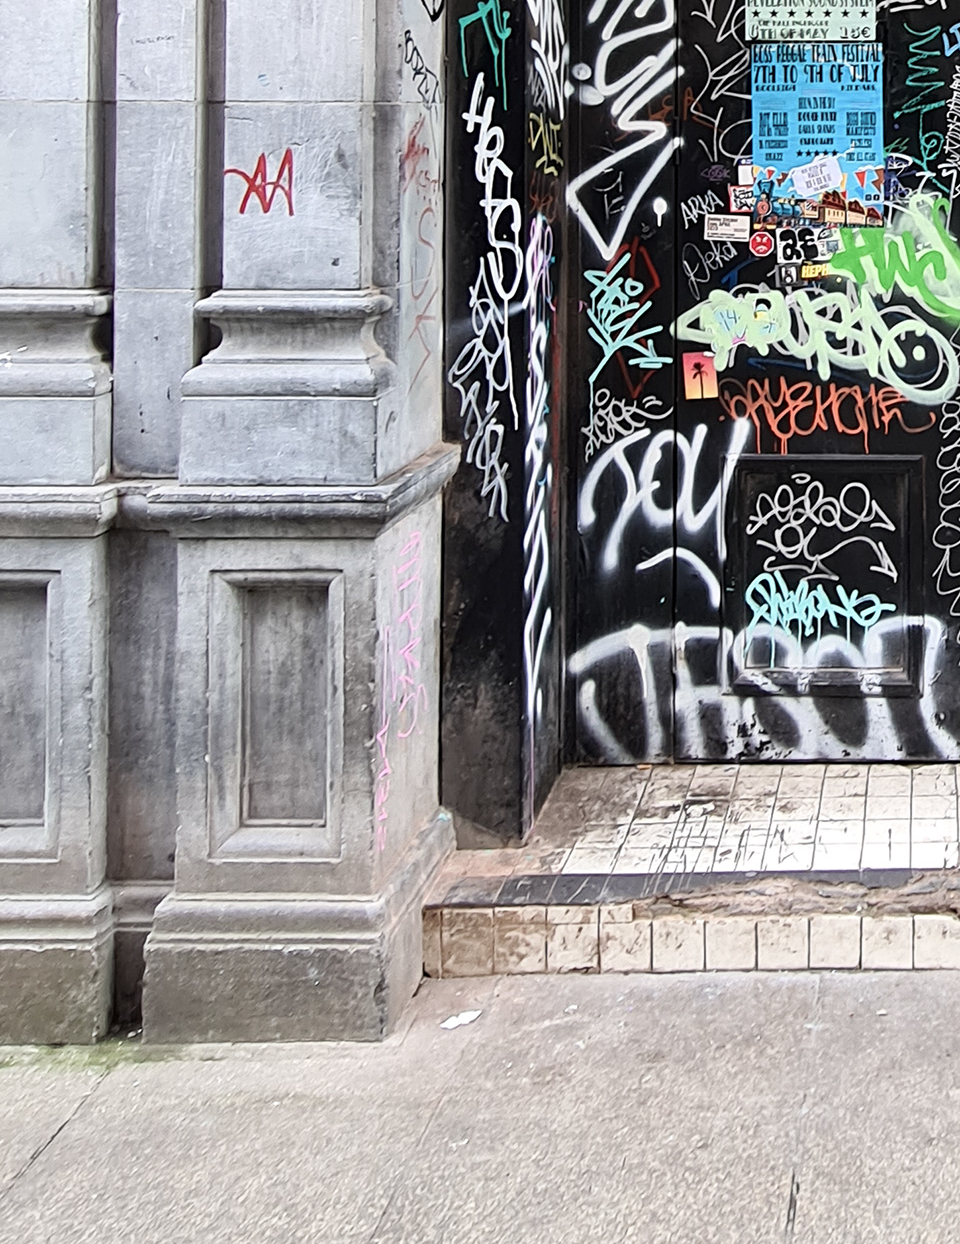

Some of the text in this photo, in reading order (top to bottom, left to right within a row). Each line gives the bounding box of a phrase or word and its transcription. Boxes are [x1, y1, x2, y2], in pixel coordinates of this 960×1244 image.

[841, 43, 882, 63] FESTIVAL
[753, 64, 777, 84] 7TH
[782, 64, 799, 84] TO
[829, 64, 844, 83] OF
[850, 64, 880, 83] JULY
